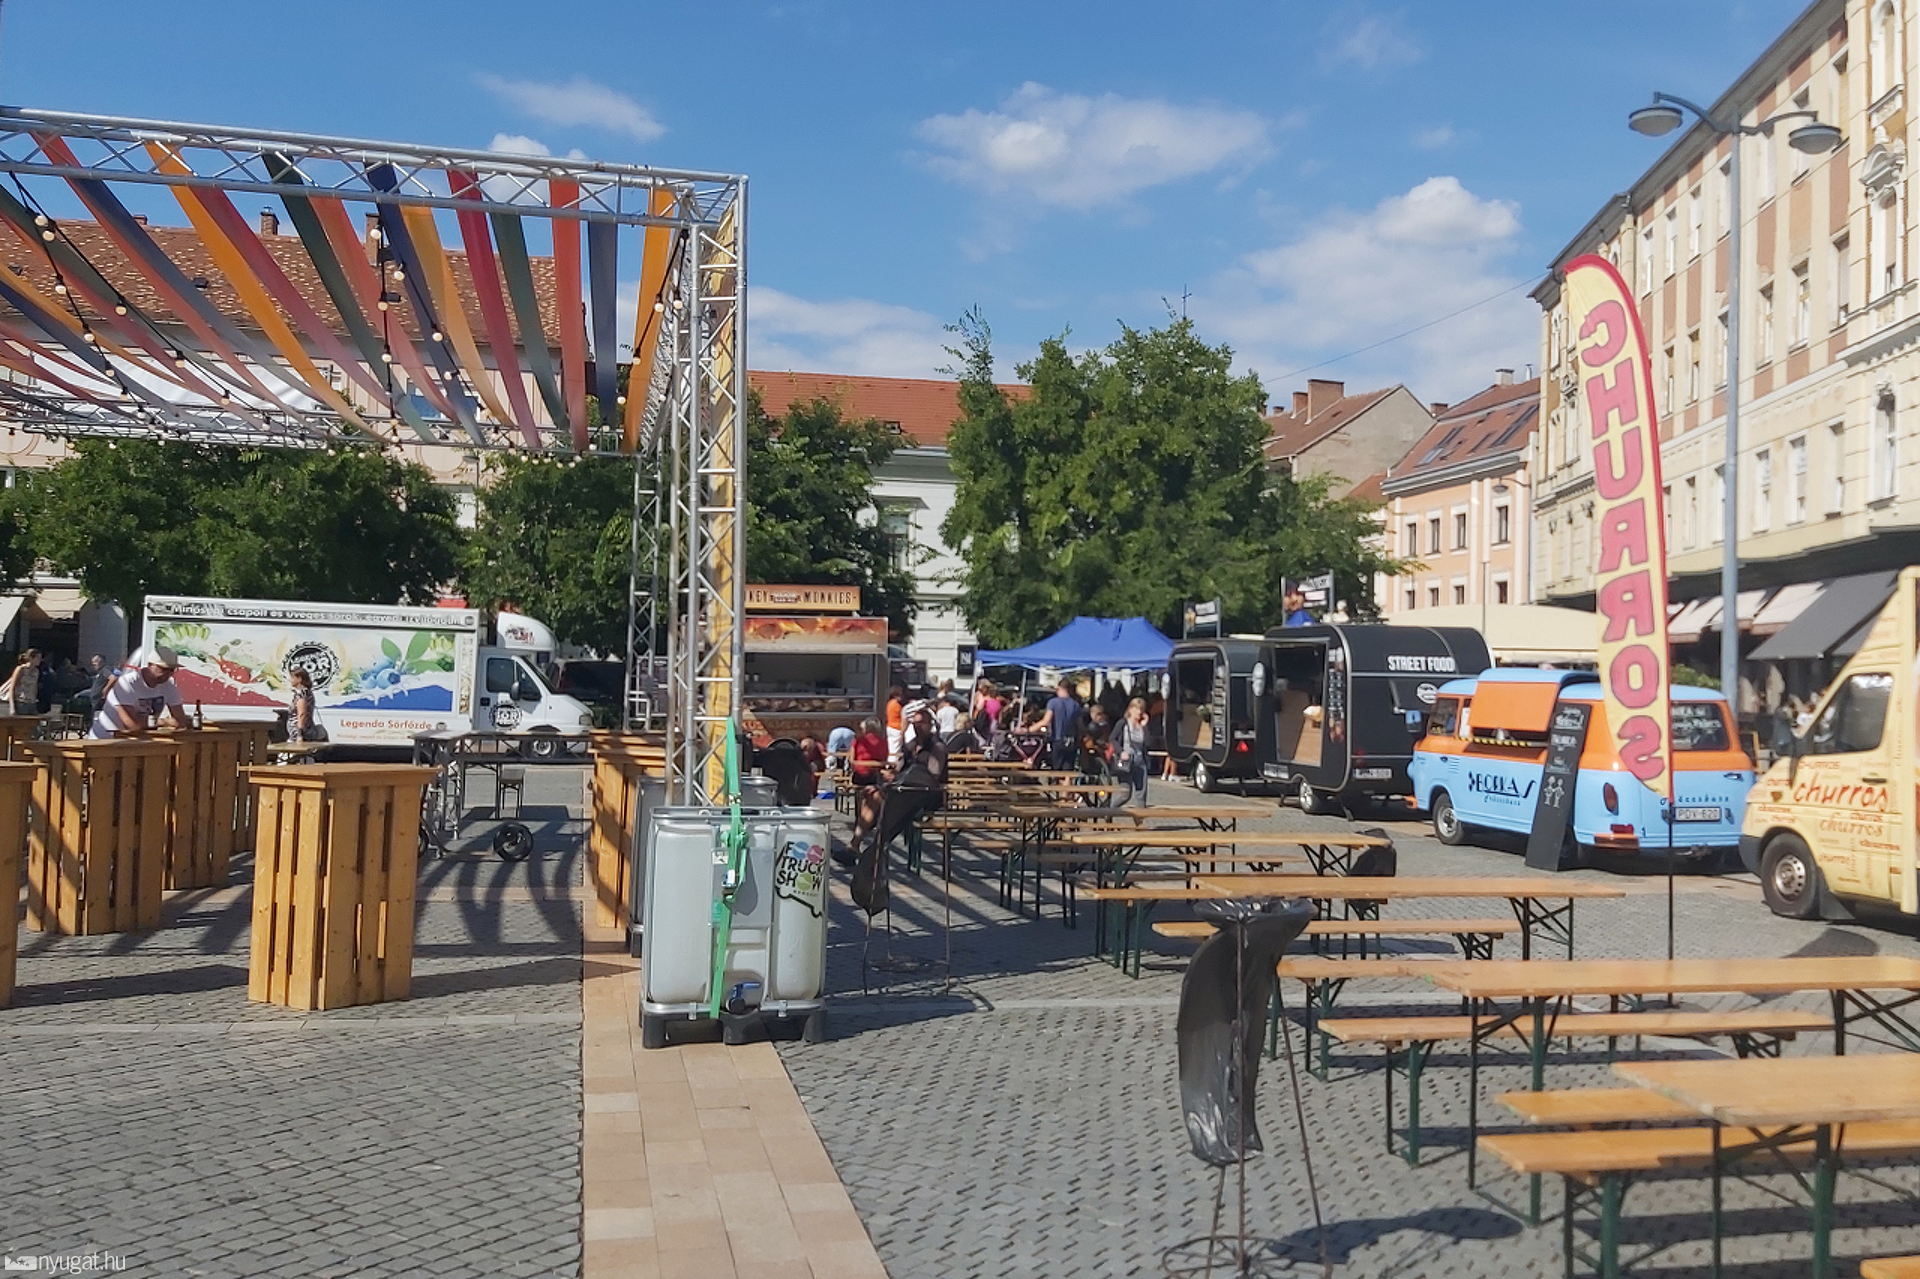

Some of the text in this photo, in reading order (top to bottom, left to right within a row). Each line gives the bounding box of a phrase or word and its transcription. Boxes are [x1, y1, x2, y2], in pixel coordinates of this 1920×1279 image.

[1387, 655, 1456, 672] STREET FOOD
[340, 719, 385, 730] Legenda
[1793, 771, 1889, 813] churros
